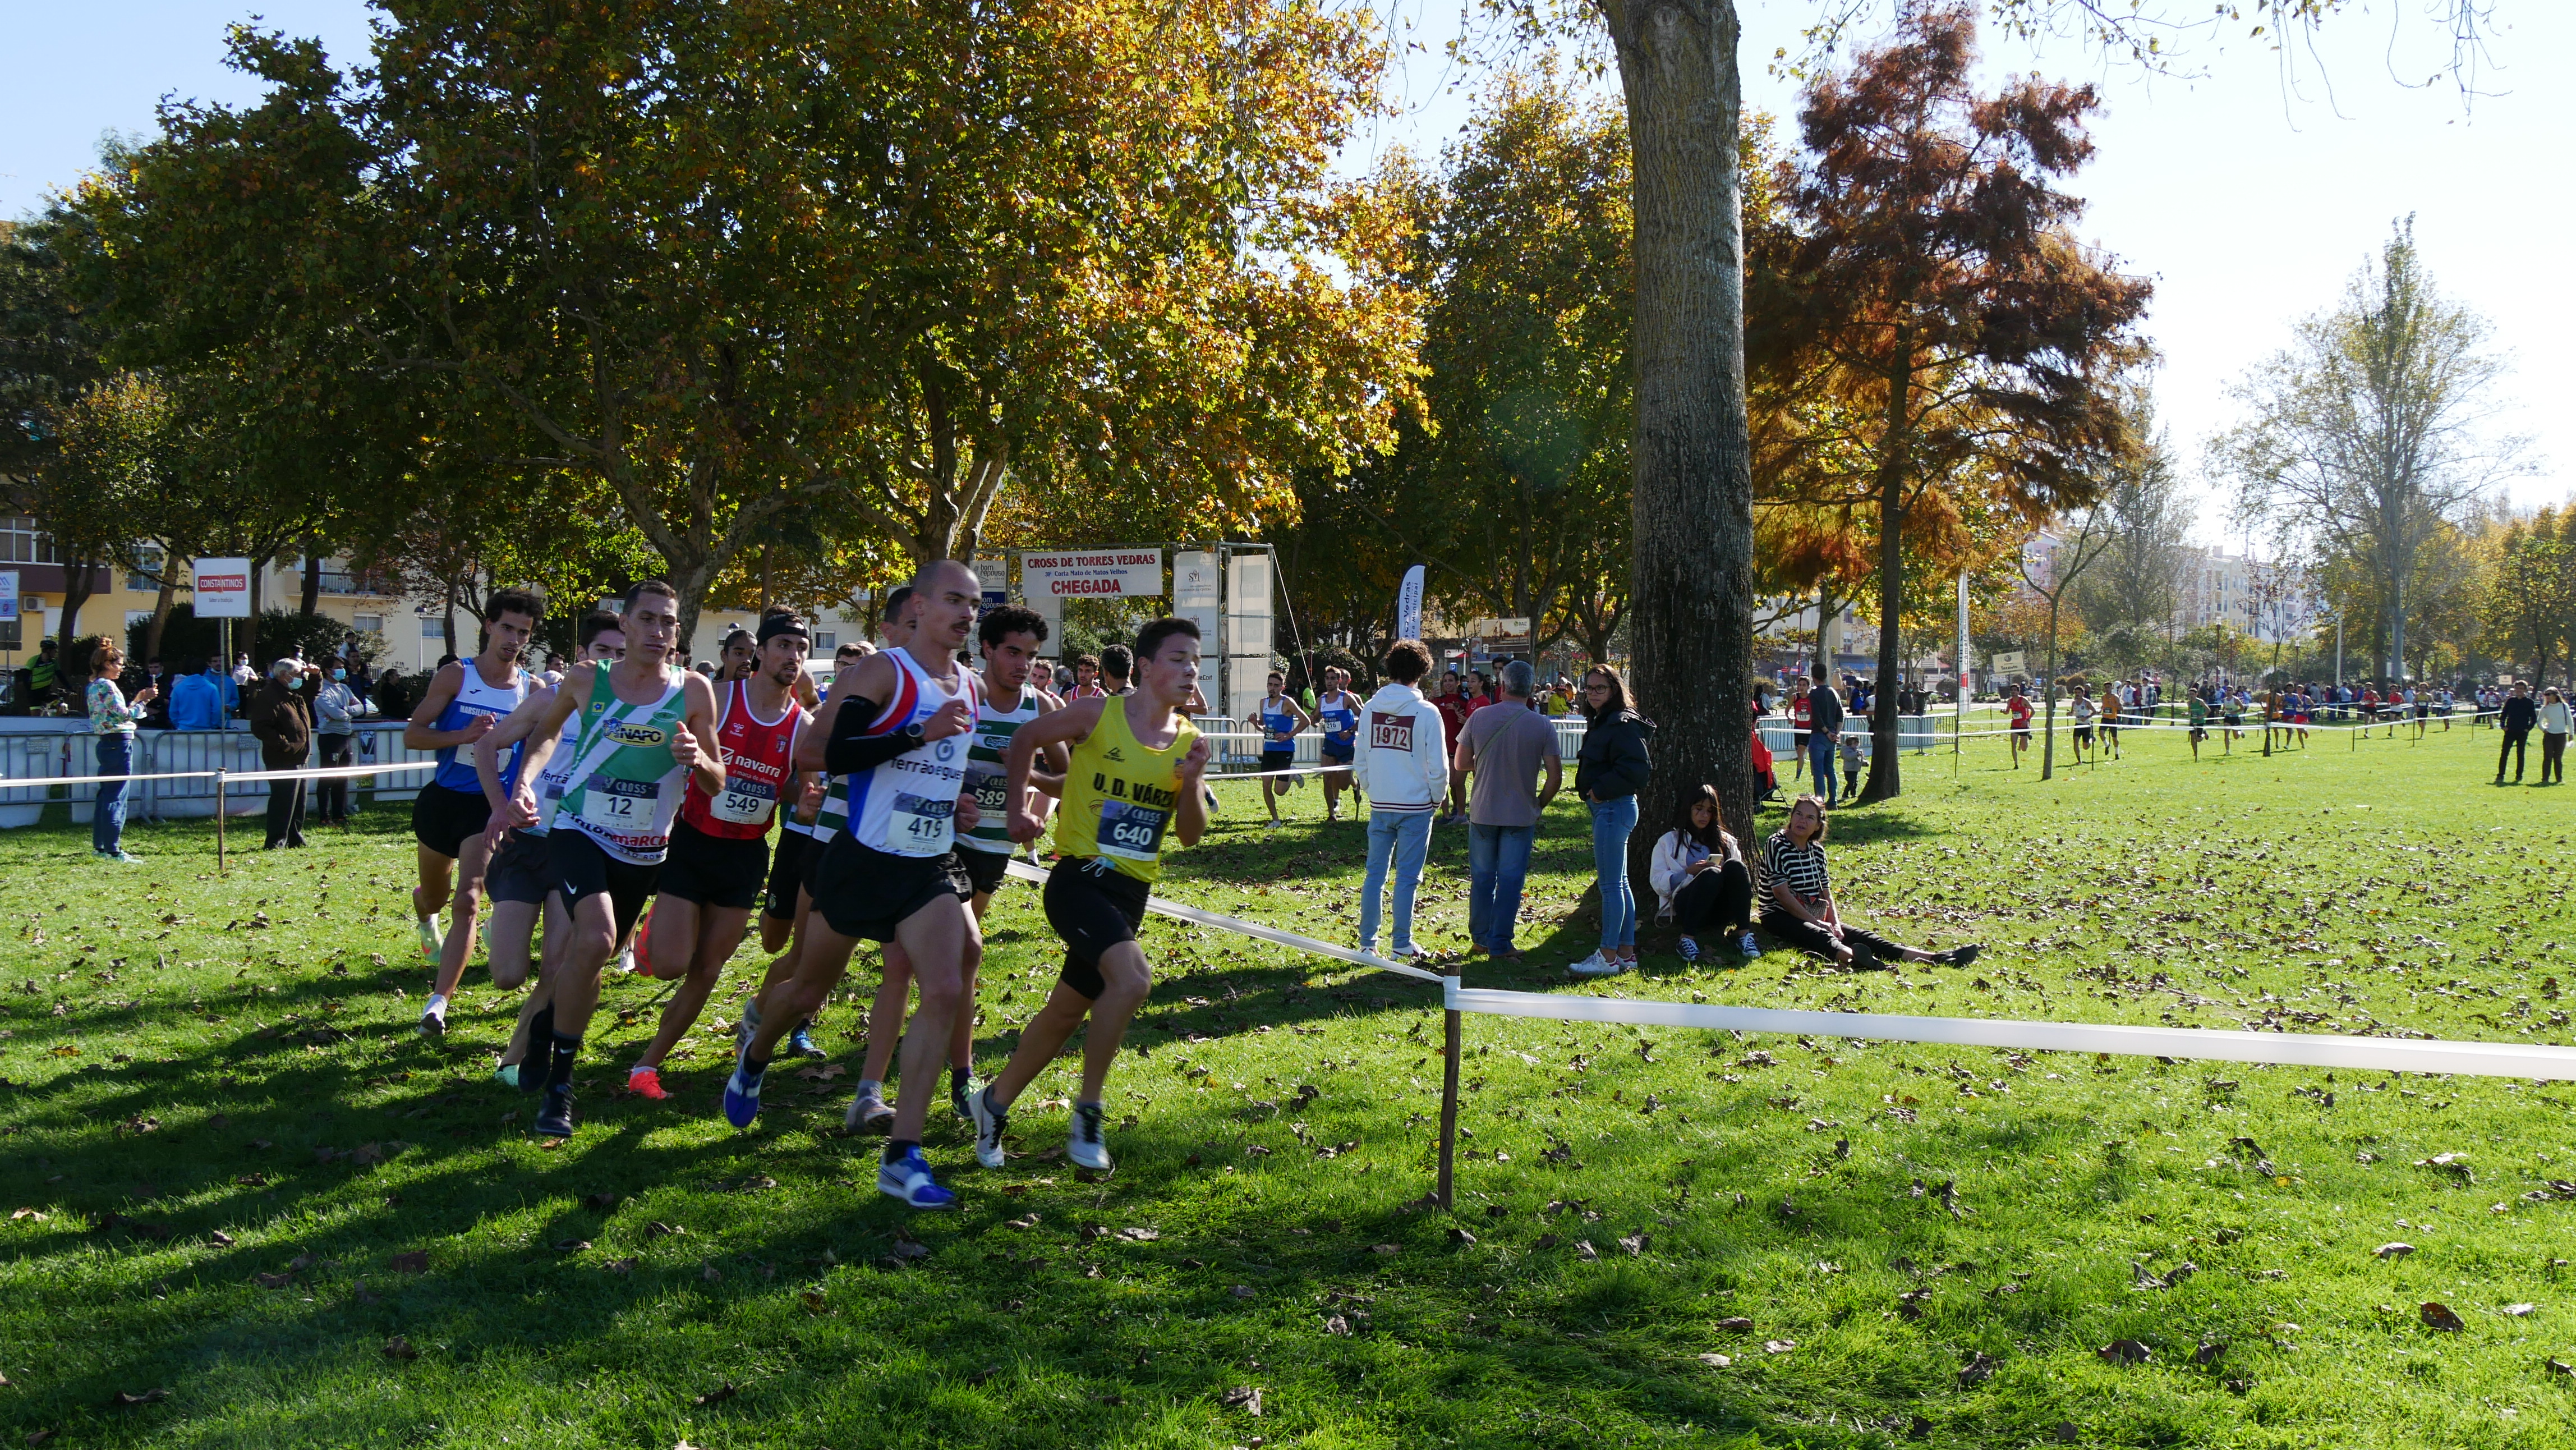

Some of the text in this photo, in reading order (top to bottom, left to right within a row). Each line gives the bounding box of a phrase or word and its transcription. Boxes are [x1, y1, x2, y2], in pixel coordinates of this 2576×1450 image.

[1028, 554, 1156, 568] CROSS DE TORRES VEDRAS
[200, 579, 243, 588] CONSTANTINOS
[1051, 579, 1121, 594] CHEGADA
[1376, 726, 1407, 747] 1972
[735, 755, 781, 778] navarra
[737, 770, 752, 779] marca
[616, 781, 647, 794] CROSS
[741, 782, 767, 795] CROSS
[725, 793, 759, 813] 549
[975, 787, 1006, 805] 589
[608, 797, 633, 815] 12
[1131, 809, 1162, 823] CROSS
[907, 817, 942, 838] 419
[1113, 823, 1153, 846] 640
